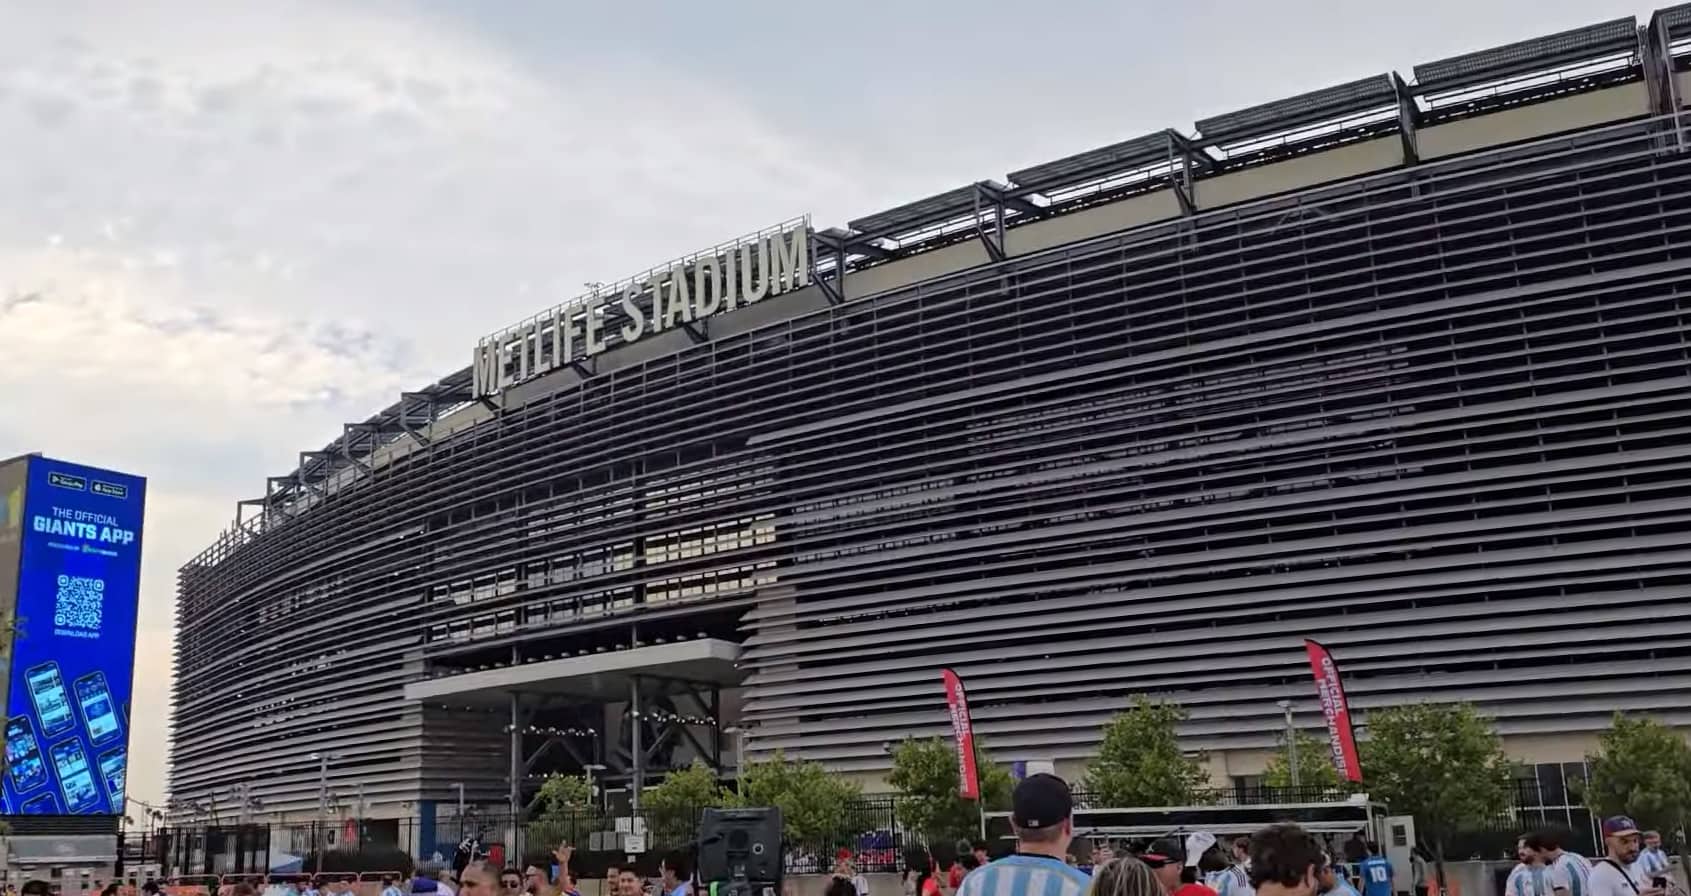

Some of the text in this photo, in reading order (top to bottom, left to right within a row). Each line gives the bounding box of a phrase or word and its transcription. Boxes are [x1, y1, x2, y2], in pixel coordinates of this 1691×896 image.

[472, 224, 808, 400] METLIFE STADIUM
[33, 515, 134, 545] GIANTS APP
[52, 506, 118, 527] THE OFFICIAL
[1322, 657, 1343, 716] OFFICIAL
[955, 682, 969, 737] OFFICIAL
[1370, 866, 1387, 882] 10
